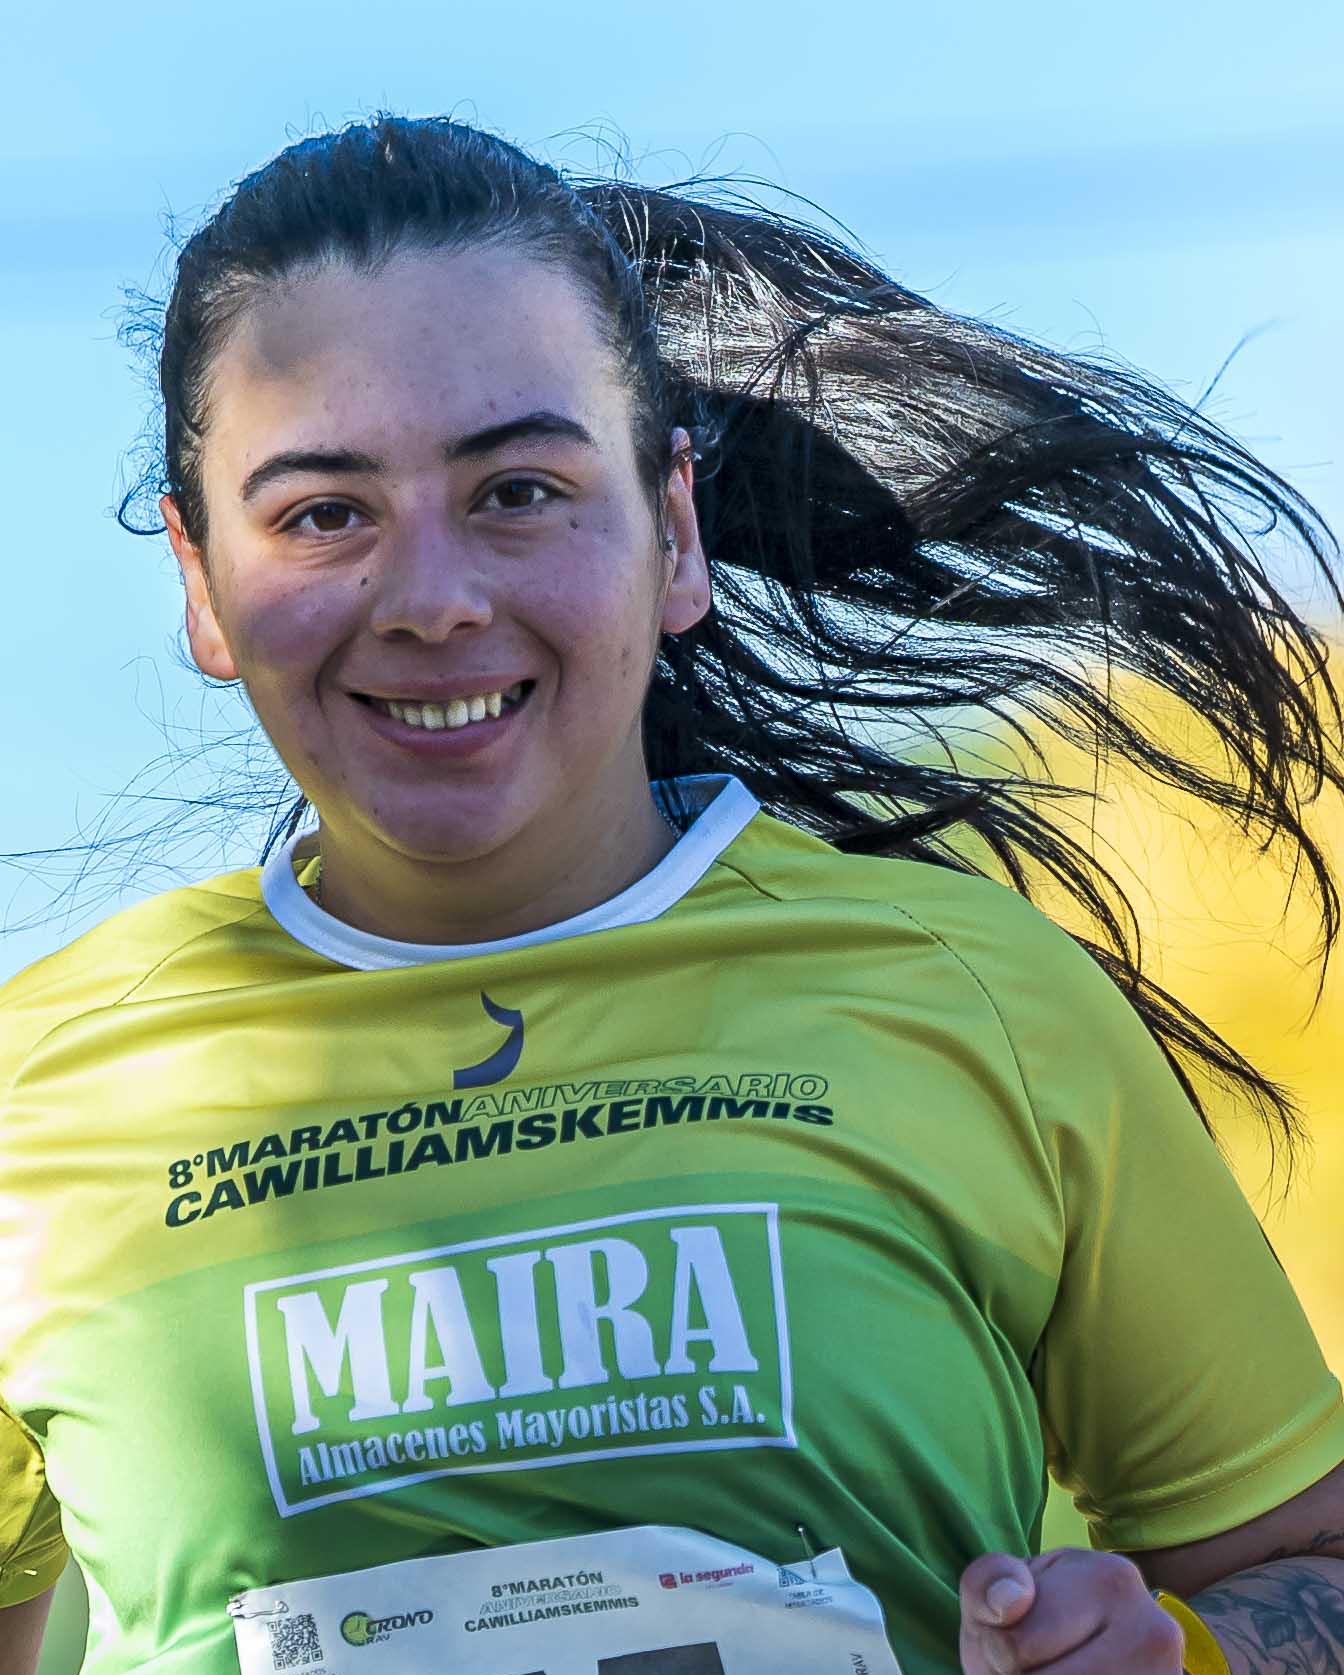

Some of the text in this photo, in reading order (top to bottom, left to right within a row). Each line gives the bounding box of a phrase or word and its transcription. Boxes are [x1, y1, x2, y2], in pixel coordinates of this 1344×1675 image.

[165, 1095, 834, 1227] CAWILLIAMSKEMMIS
[276, 1226, 757, 1435] MAIRA
[297, 1385, 767, 1486] Almacenes Mayoristas S.A.
[464, 1596, 639, 1633] CAWILLIAMSKEMMIS
[680, 1571, 694, 1585] la
[696, 1562, 754, 1582] segunda
